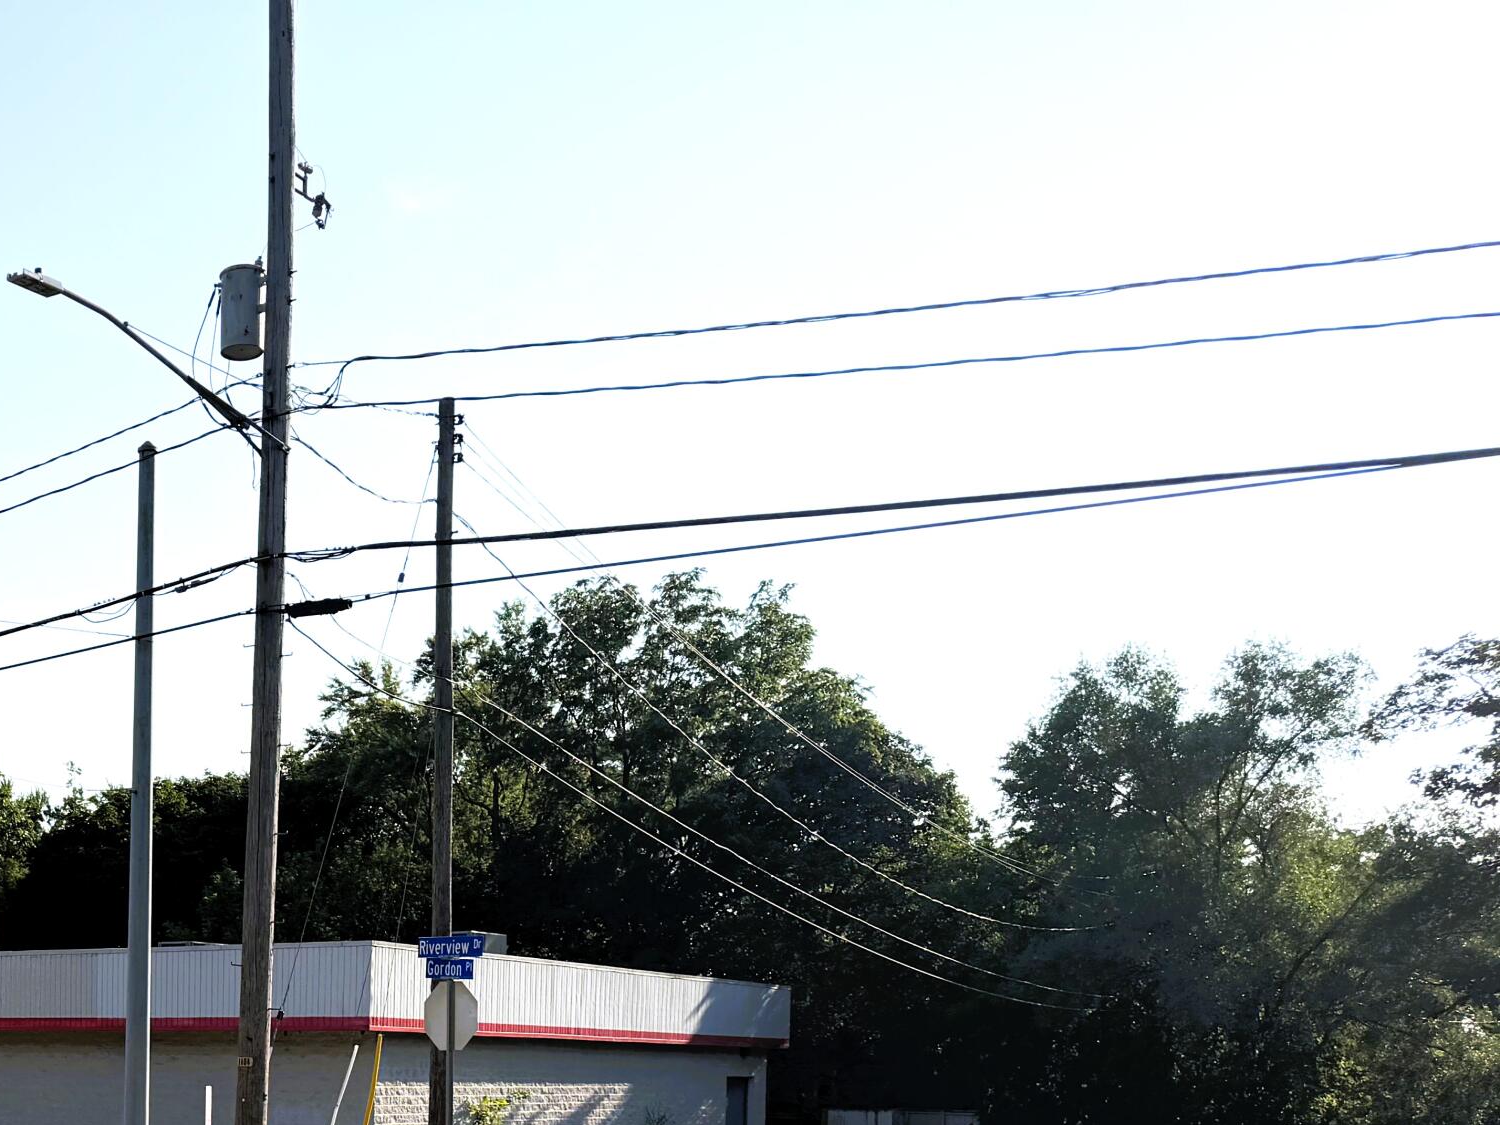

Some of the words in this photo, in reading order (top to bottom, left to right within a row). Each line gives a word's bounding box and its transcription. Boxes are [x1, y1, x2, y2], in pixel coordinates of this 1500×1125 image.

[419, 939, 470, 955] Riverview
[473, 938, 482, 949] Dr
[427, 960, 462, 976] Gordon
[465, 961, 473, 972] Pl
